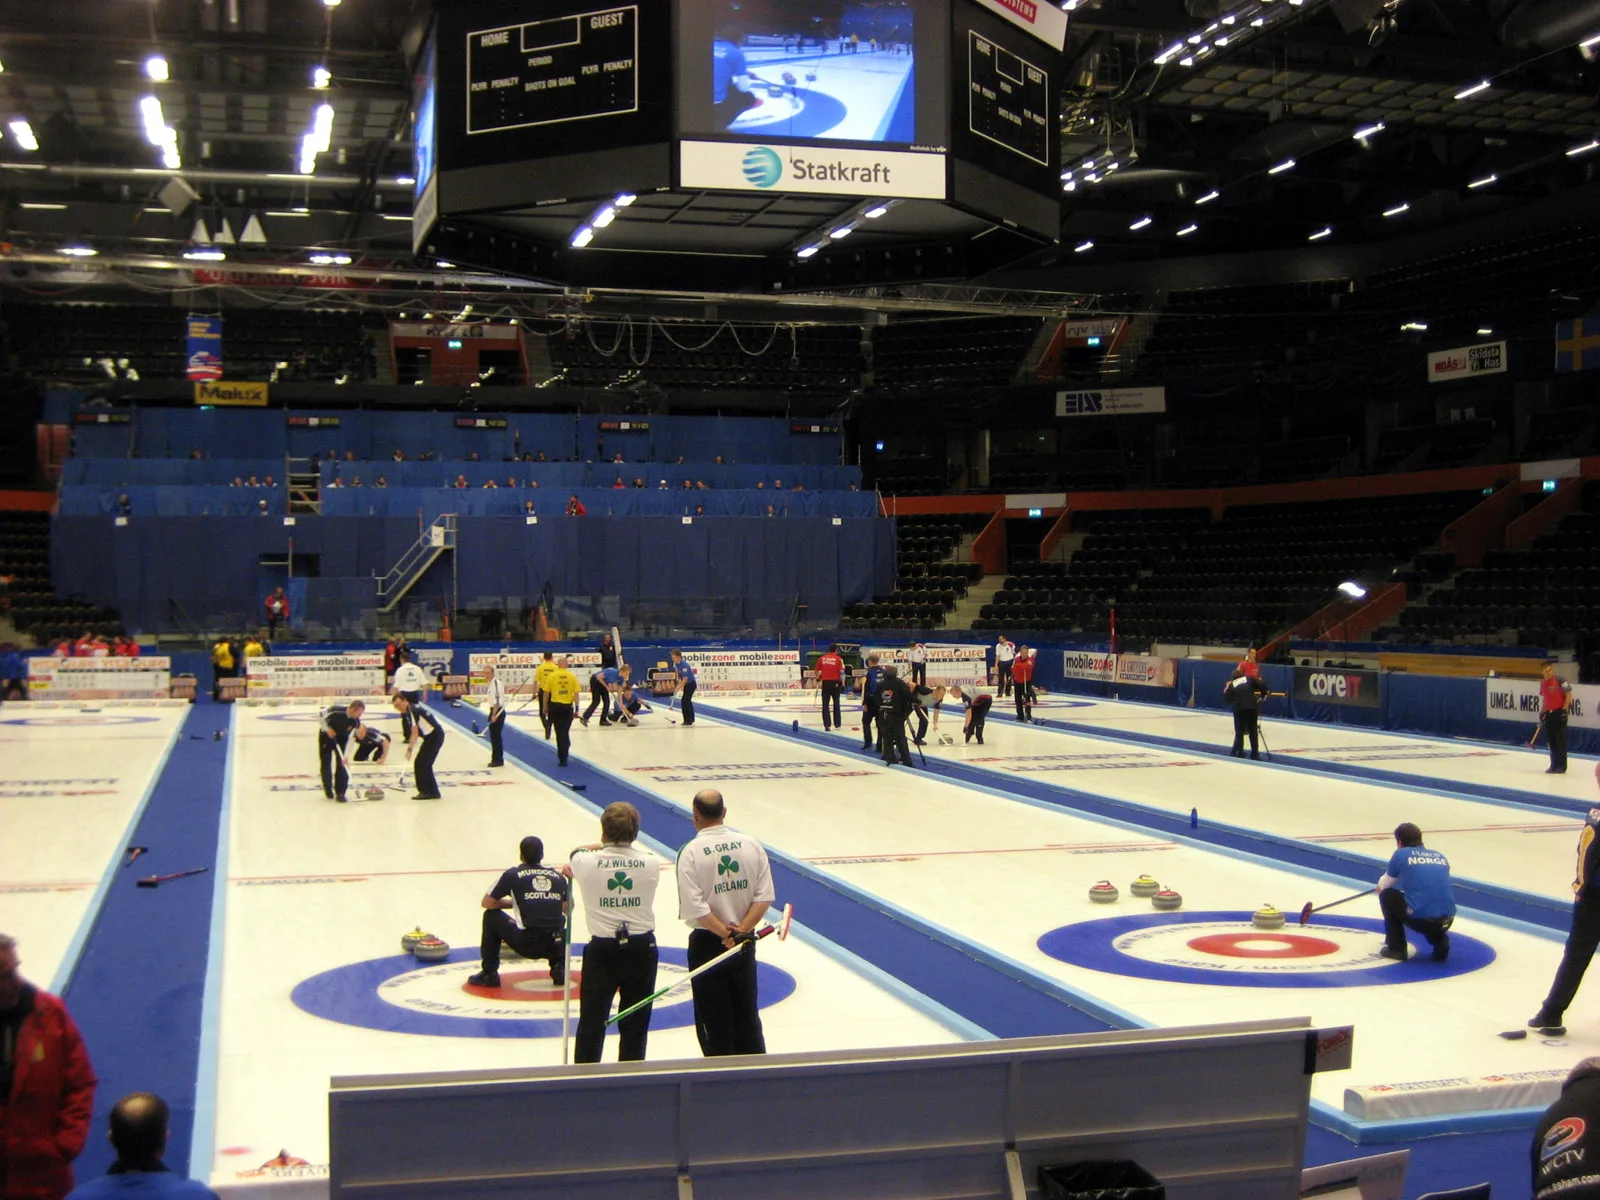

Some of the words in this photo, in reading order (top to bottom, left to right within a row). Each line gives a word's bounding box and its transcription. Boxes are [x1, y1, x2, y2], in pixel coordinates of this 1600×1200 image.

[591, 13, 624, 29] GUEST
[481, 32, 509, 47] HOME
[528, 56, 552, 67] PERIOD
[603, 59, 633, 72] PENALTY
[491, 77, 520, 89] PENALTY
[525, 81, 546, 92] SHOTS
[793, 159, 890, 183] Statkraft
[249, 659, 314, 667] mobilezone
[317, 657, 382, 666] mobilezone
[740, 652, 798, 661] mobilezone
[1066, 654, 1114, 671] mobilezone
[703, 841, 742, 856] B.GRAY
[714, 879, 748, 894] IRELAND
[524, 892, 561, 900] SCOTLAND
[599, 896, 641, 907] IRELAND
[1541, 1148, 1585, 1175] WCTV
